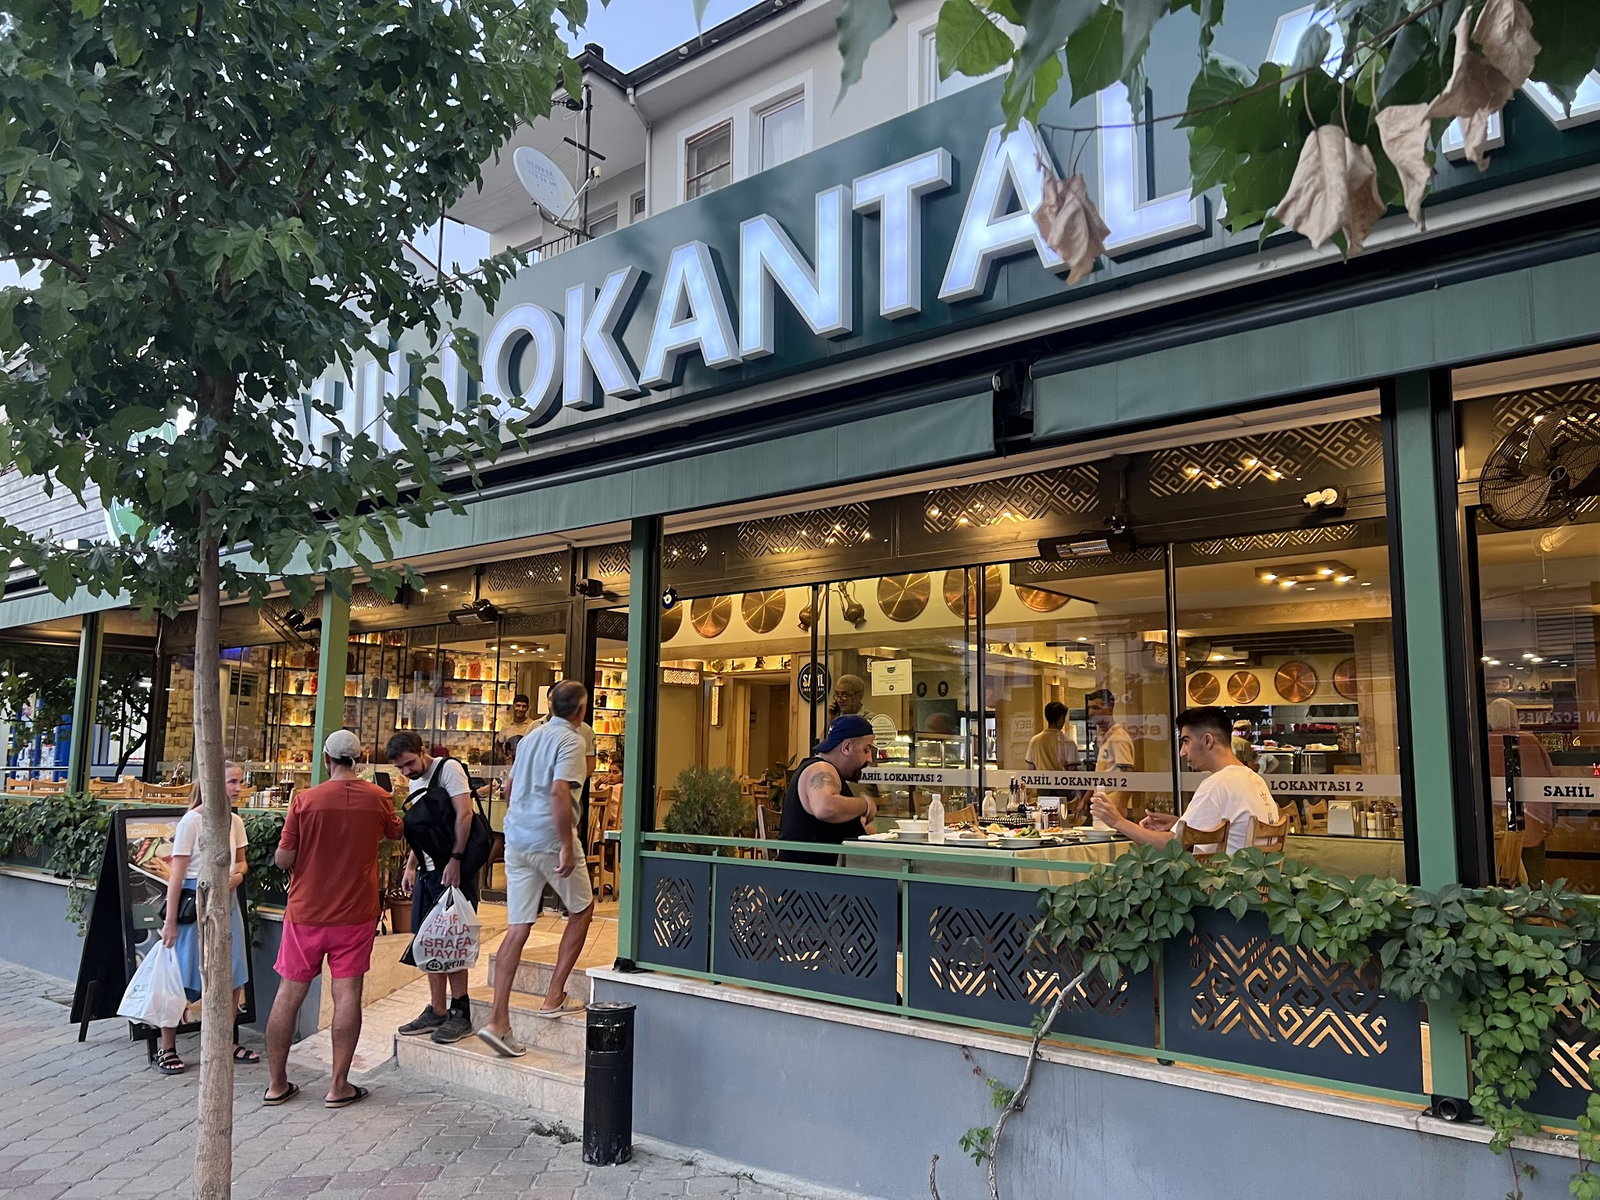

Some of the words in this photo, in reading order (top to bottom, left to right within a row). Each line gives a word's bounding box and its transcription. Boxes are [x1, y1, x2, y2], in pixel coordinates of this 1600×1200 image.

[858, 770, 882, 781] AHİL
[883, 772, 935, 783] LOKANTASI
[936, 773, 943, 783] 2
[1020, 773, 1052, 785] SAHİL
[1054, 776, 1118, 787] LOKANTASI
[1120, 777, 1128, 788] 2
[1270, 780, 1351, 792] LOKANTASI
[1355, 781, 1364, 792] 2
[1543, 782, 1595, 798] SAHİL
[424, 947, 468, 959] HAYIR
